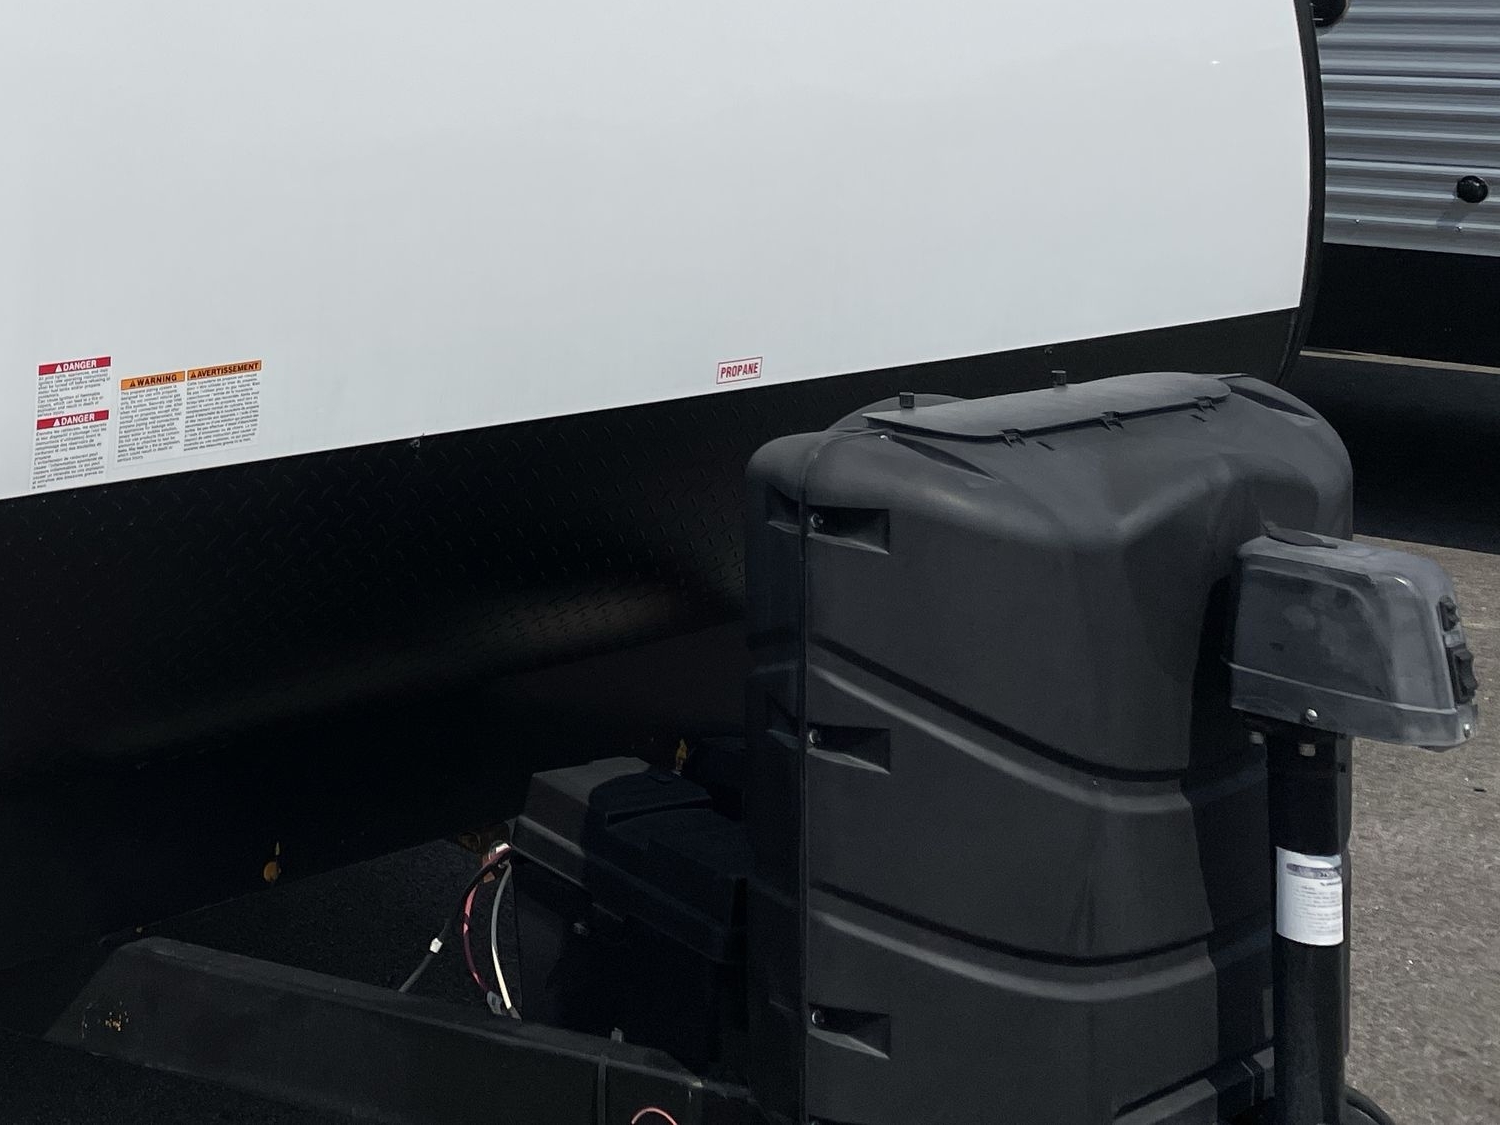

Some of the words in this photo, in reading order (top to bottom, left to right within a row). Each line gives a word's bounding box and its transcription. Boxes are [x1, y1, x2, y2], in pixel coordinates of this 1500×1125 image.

[63, 360, 97, 372] DANGER
[197, 362, 259, 377] AVERTISSEMENT
[720, 363, 759, 378] PROPANE
[137, 374, 177, 386] WARNING
[61, 413, 95, 425] DANGER
